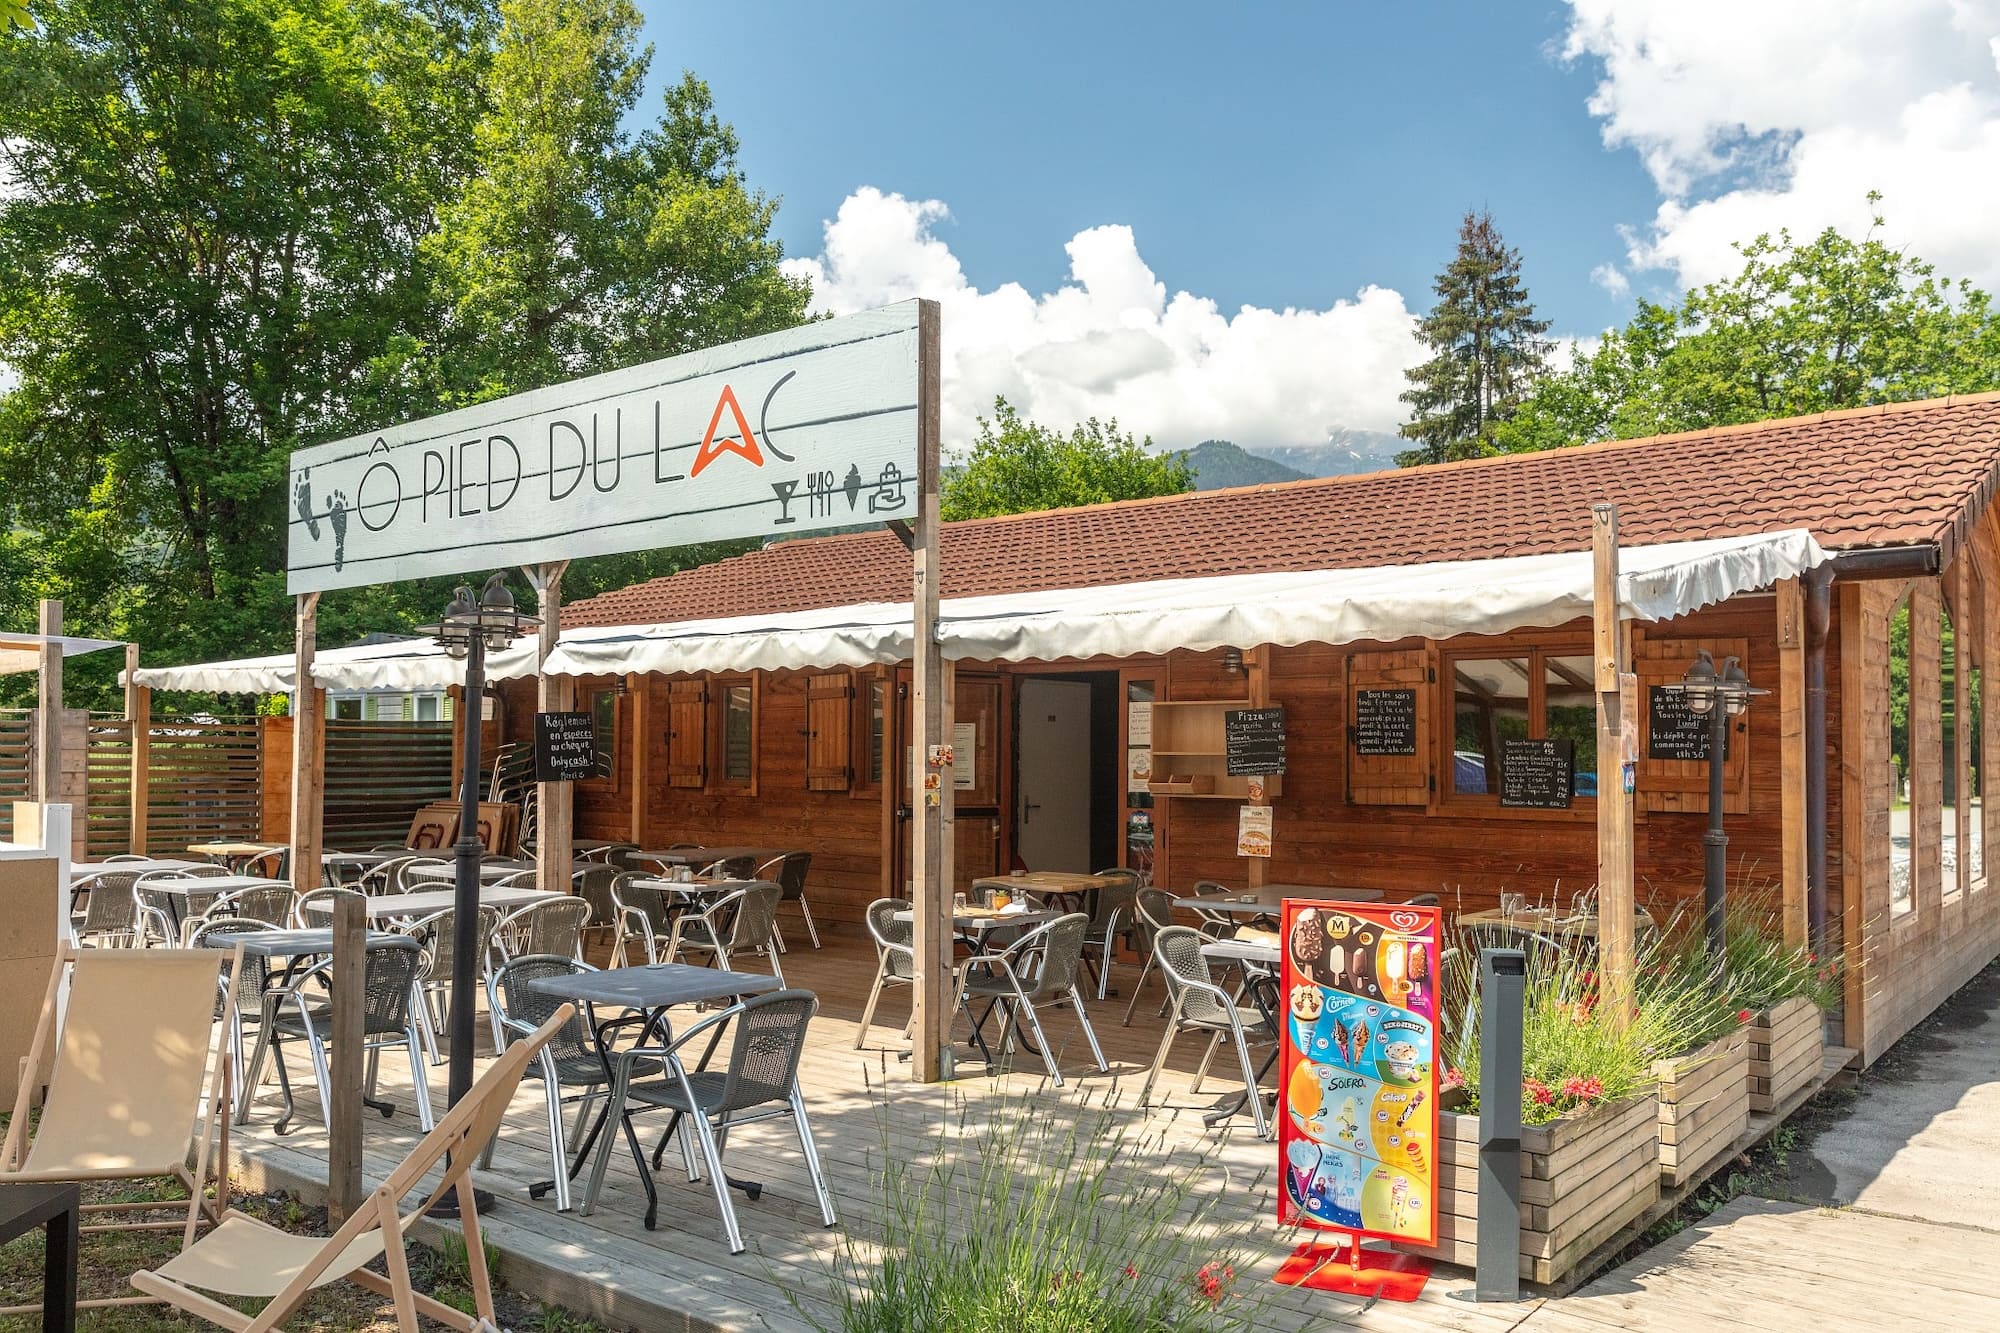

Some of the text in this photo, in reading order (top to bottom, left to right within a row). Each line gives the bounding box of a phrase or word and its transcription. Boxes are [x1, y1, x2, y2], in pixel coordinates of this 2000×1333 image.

[357, 369, 797, 532] Ô PIED DU LAC
[1367, 691, 1380, 699] Tous
[1395, 692, 1410, 700] soirs
[1238, 711, 1264, 721] Pizza
[1659, 711, 1708, 721] Tous les jours
[1391, 722, 1411, 730] carte
[550, 732, 560, 740] en
[1663, 731, 1685, 741] dépôt
[1687, 732, 1697, 740] de
[551, 755, 569, 768] Only
[1332, 920, 1344, 932] M
